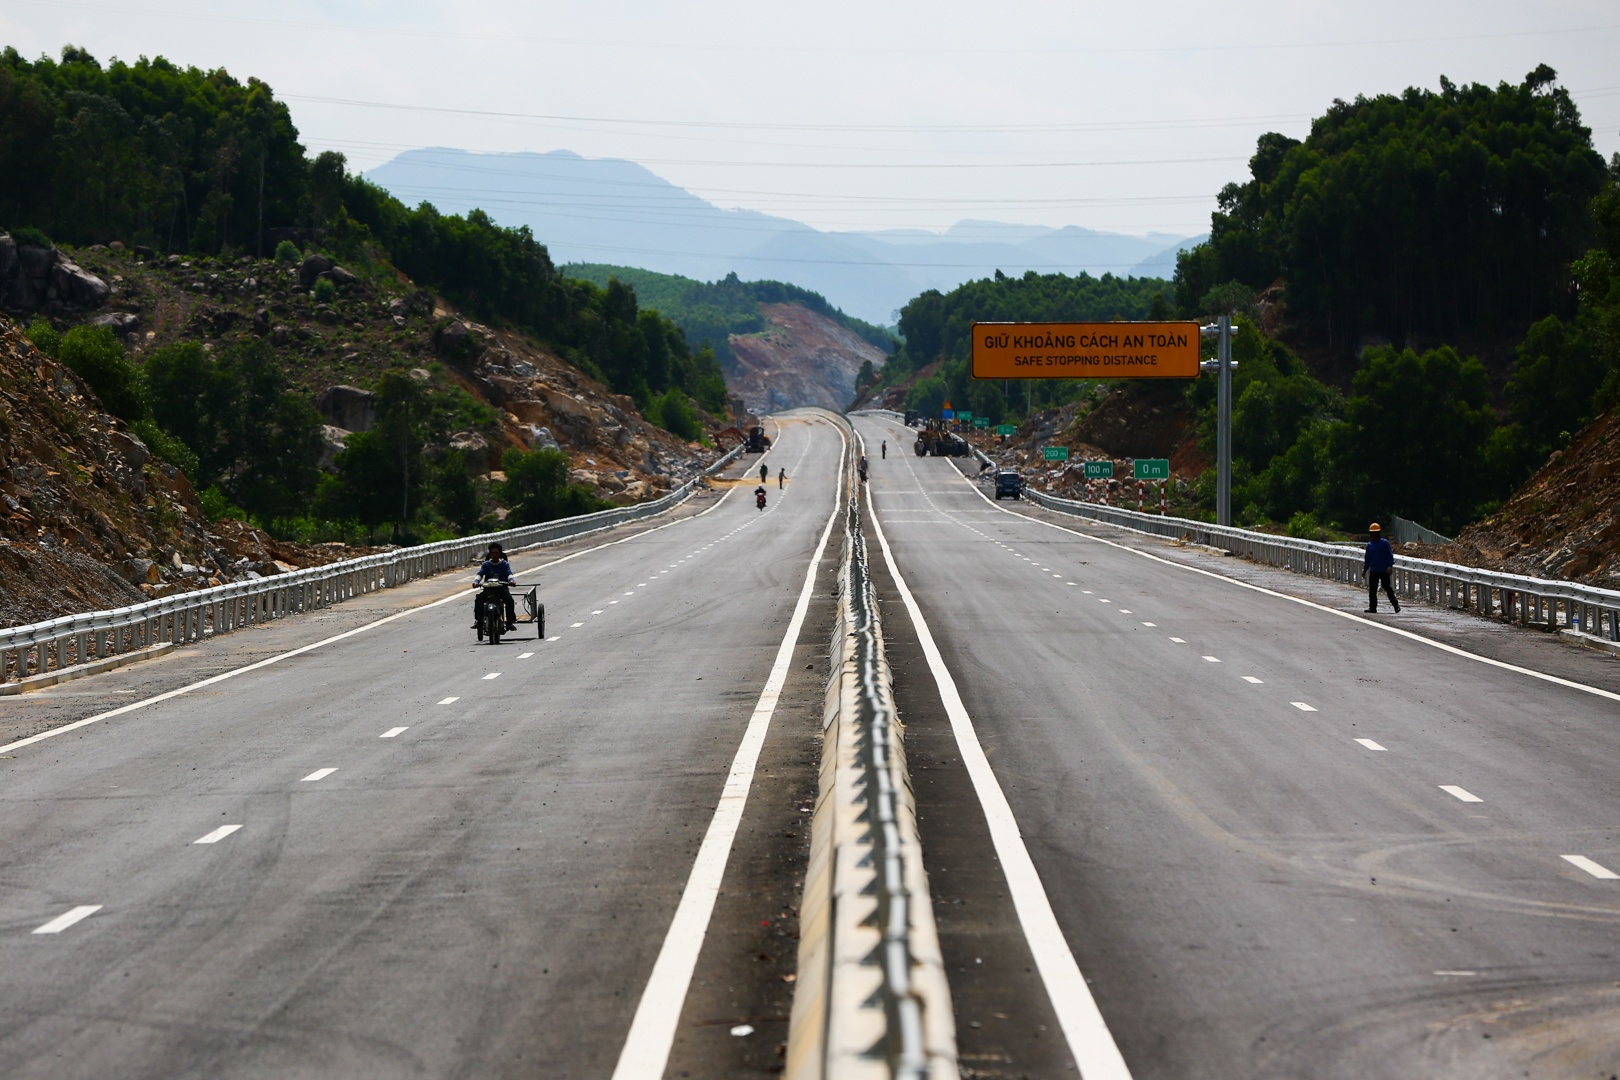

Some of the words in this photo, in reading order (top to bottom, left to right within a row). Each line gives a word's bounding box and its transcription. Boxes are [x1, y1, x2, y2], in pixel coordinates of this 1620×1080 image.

[984, 332, 1010, 348] GIỮ
[1014, 331, 1076, 348] KHOẢNG
[1080, 332, 1118, 348] CÁCH
[1122, 335, 1144, 348] AN
[1148, 331, 1187, 348] TOÀN
[1014, 356, 1042, 366] SAFE
[1046, 356, 1100, 366] STOPPING
[1103, 355, 1157, 366] DISTANCE
[1087, 465, 1100, 474] 100
[1142, 464, 1148, 474] 0
